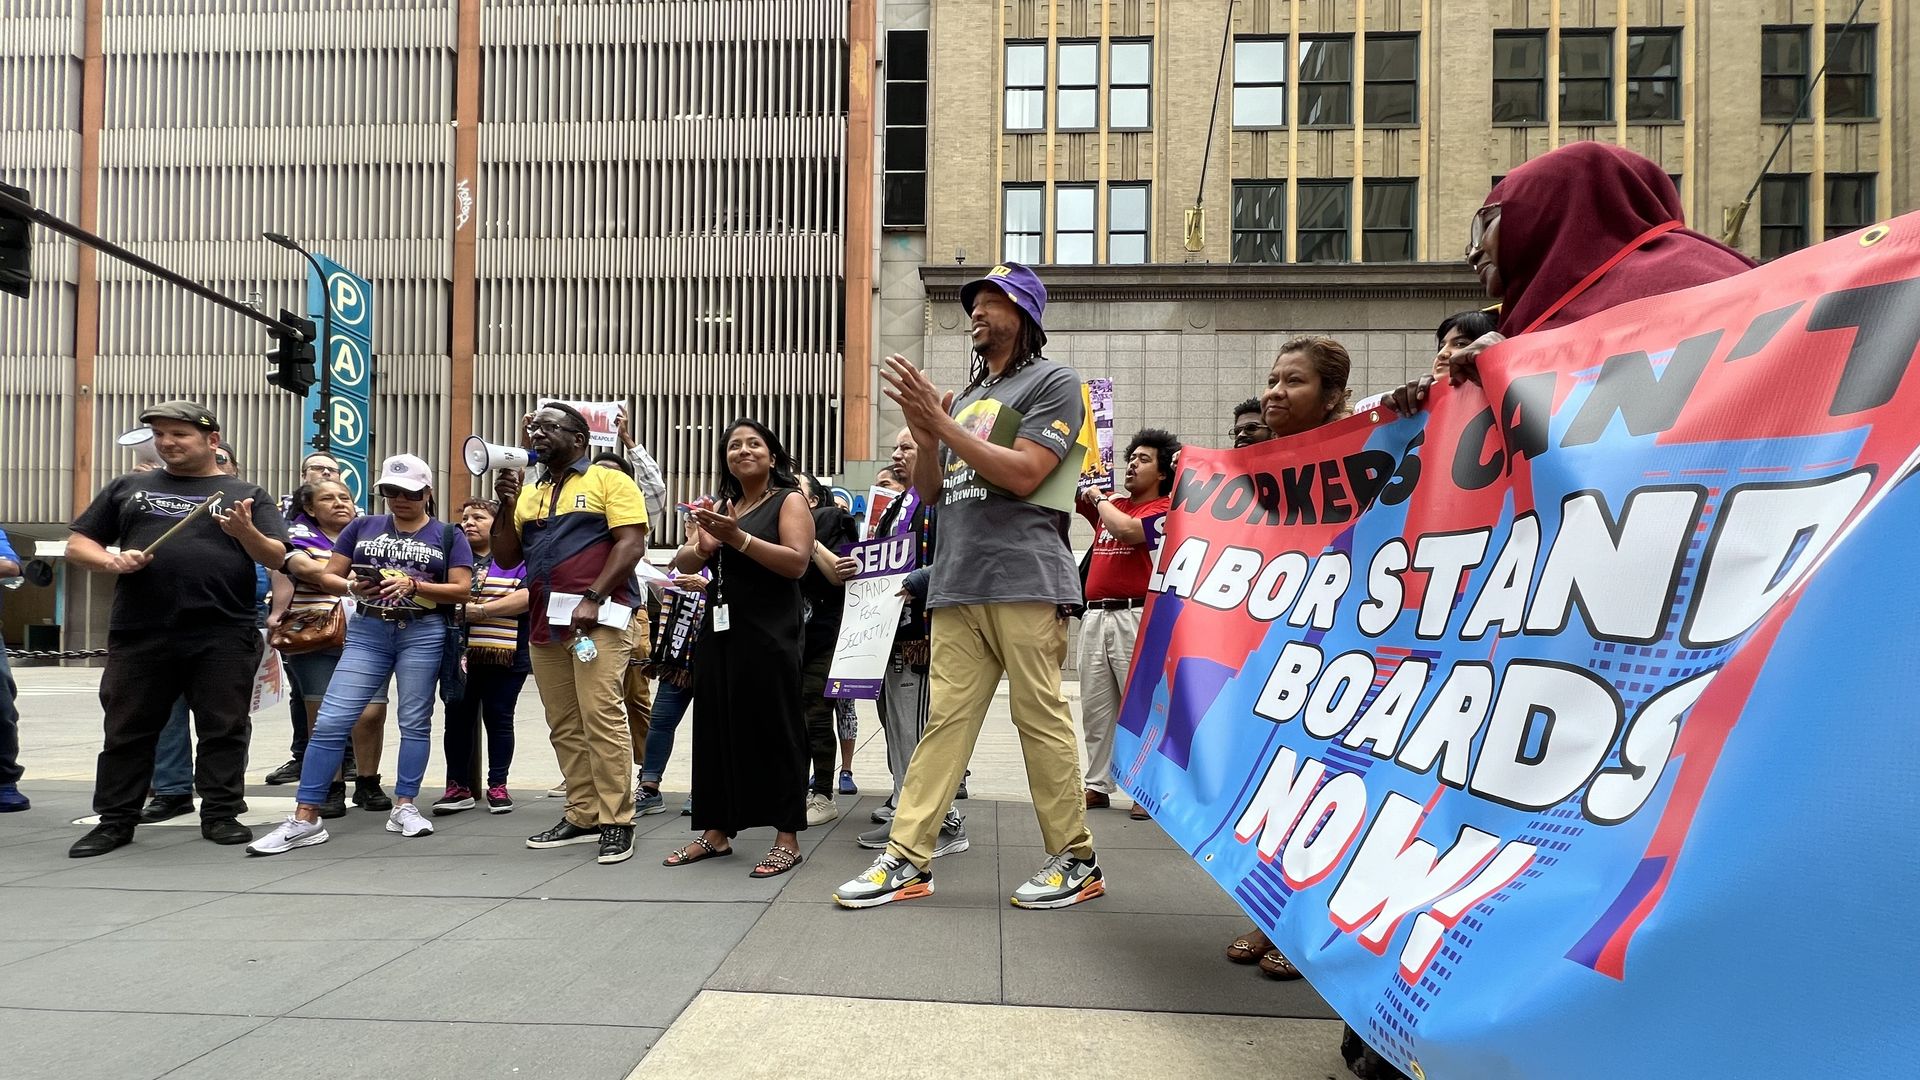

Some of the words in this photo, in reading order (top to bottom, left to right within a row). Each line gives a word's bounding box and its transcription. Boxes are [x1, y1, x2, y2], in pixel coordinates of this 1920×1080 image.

[1170, 430, 1425, 527] WORKERS
[1451, 278, 1920, 490] CAN'T
[364, 546, 385, 558] CON
[848, 577, 891, 608] STAND
[850, 538, 910, 576] SEIU
[1148, 535, 1352, 632] LABOR
[1357, 464, 1879, 649] STAND
[859, 604, 881, 622] FOR
[1252, 640, 1719, 826] BOARDS
[1233, 745, 1538, 986] NOW!
